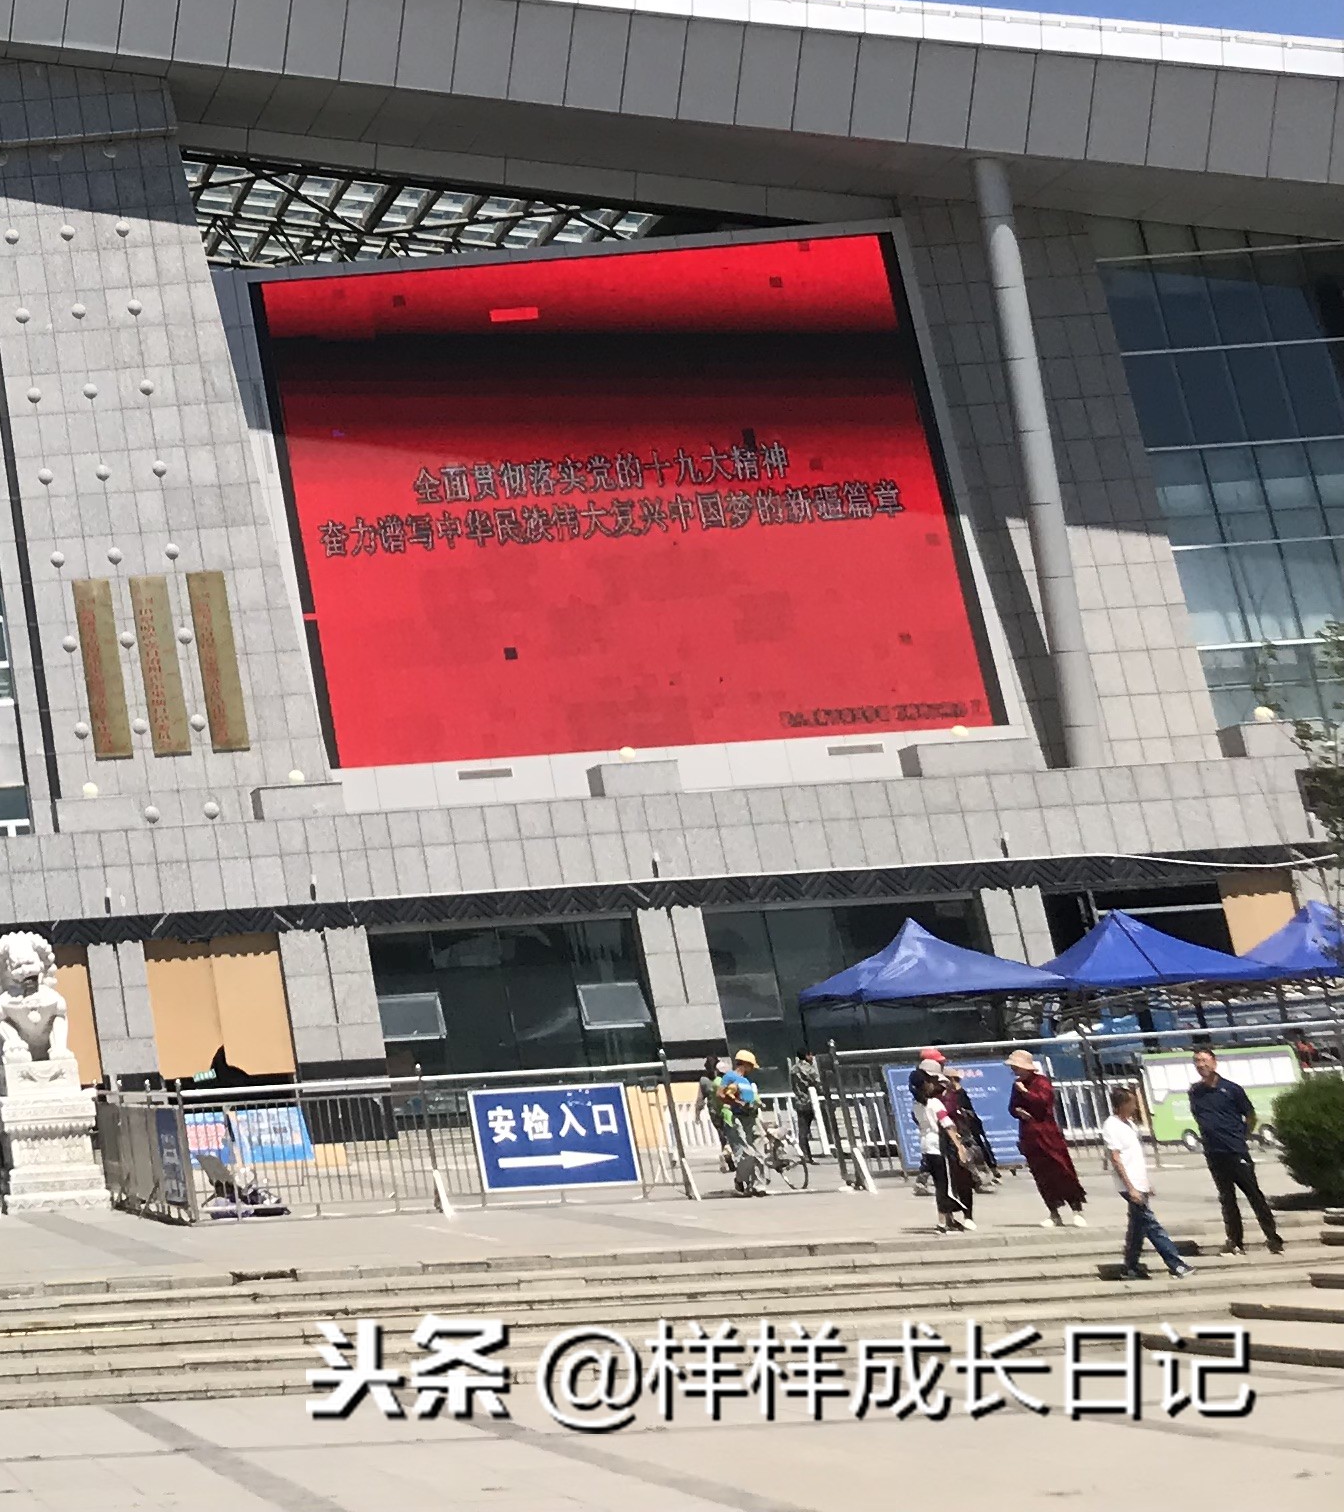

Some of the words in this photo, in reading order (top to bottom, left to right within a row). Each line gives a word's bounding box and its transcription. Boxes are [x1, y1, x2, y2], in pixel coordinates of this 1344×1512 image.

[414, 441, 790, 504] 全面贯彻落实党的十九大精神
[319, 479, 904, 558] 奋力谱写中华民族伟大复兴中国梦的新疆篇章
[487, 1103, 619, 1144] 安检入口
